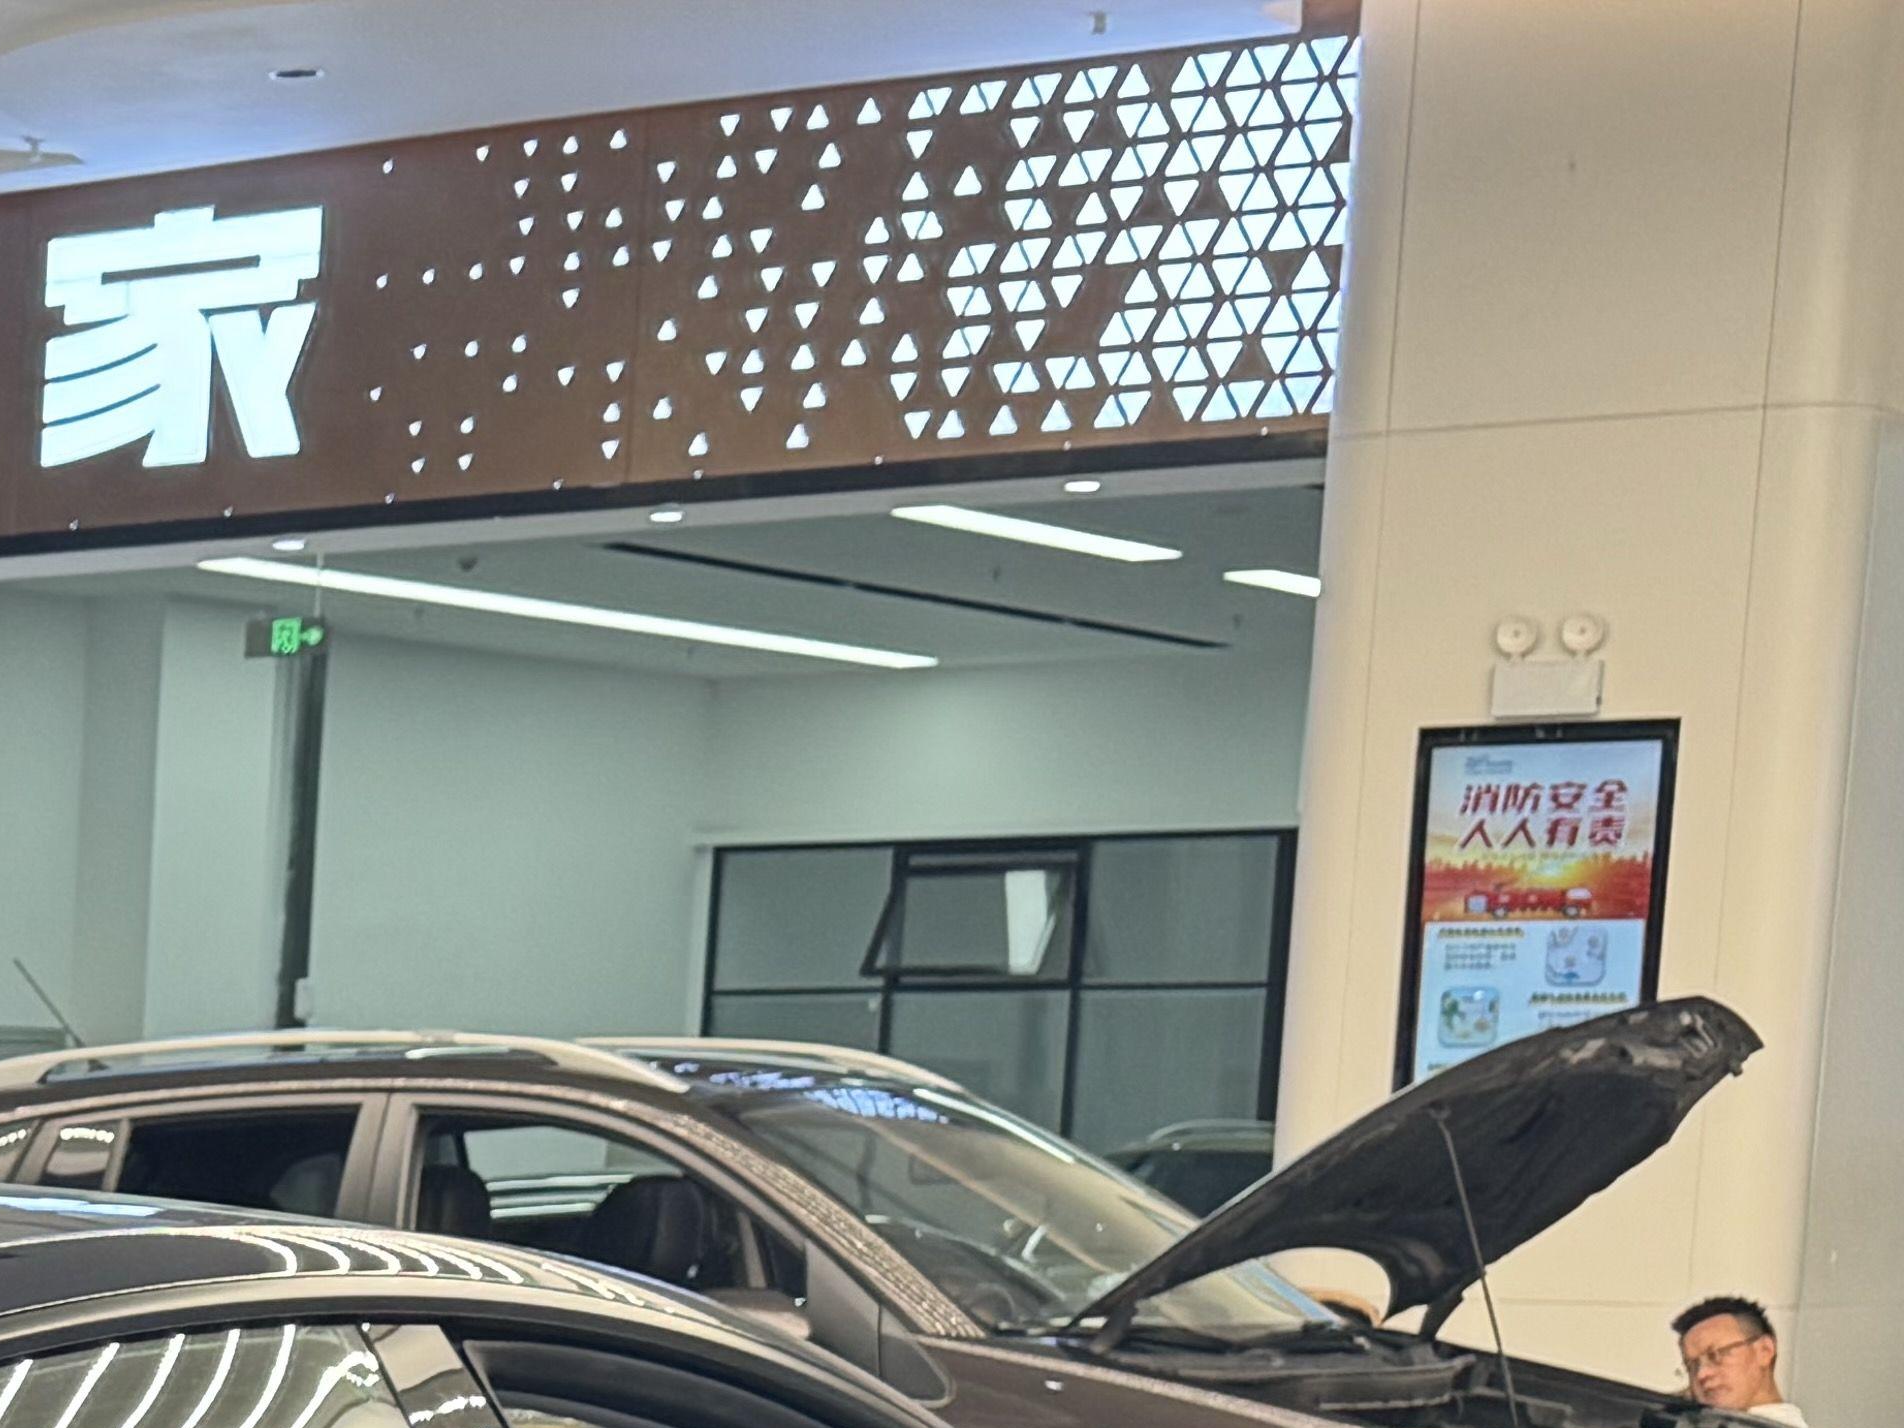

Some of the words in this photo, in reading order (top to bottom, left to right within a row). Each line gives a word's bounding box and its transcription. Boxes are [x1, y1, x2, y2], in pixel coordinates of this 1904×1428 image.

[1459, 779, 1629, 817] 消防安全
[1459, 815, 1627, 850] 人人有责
